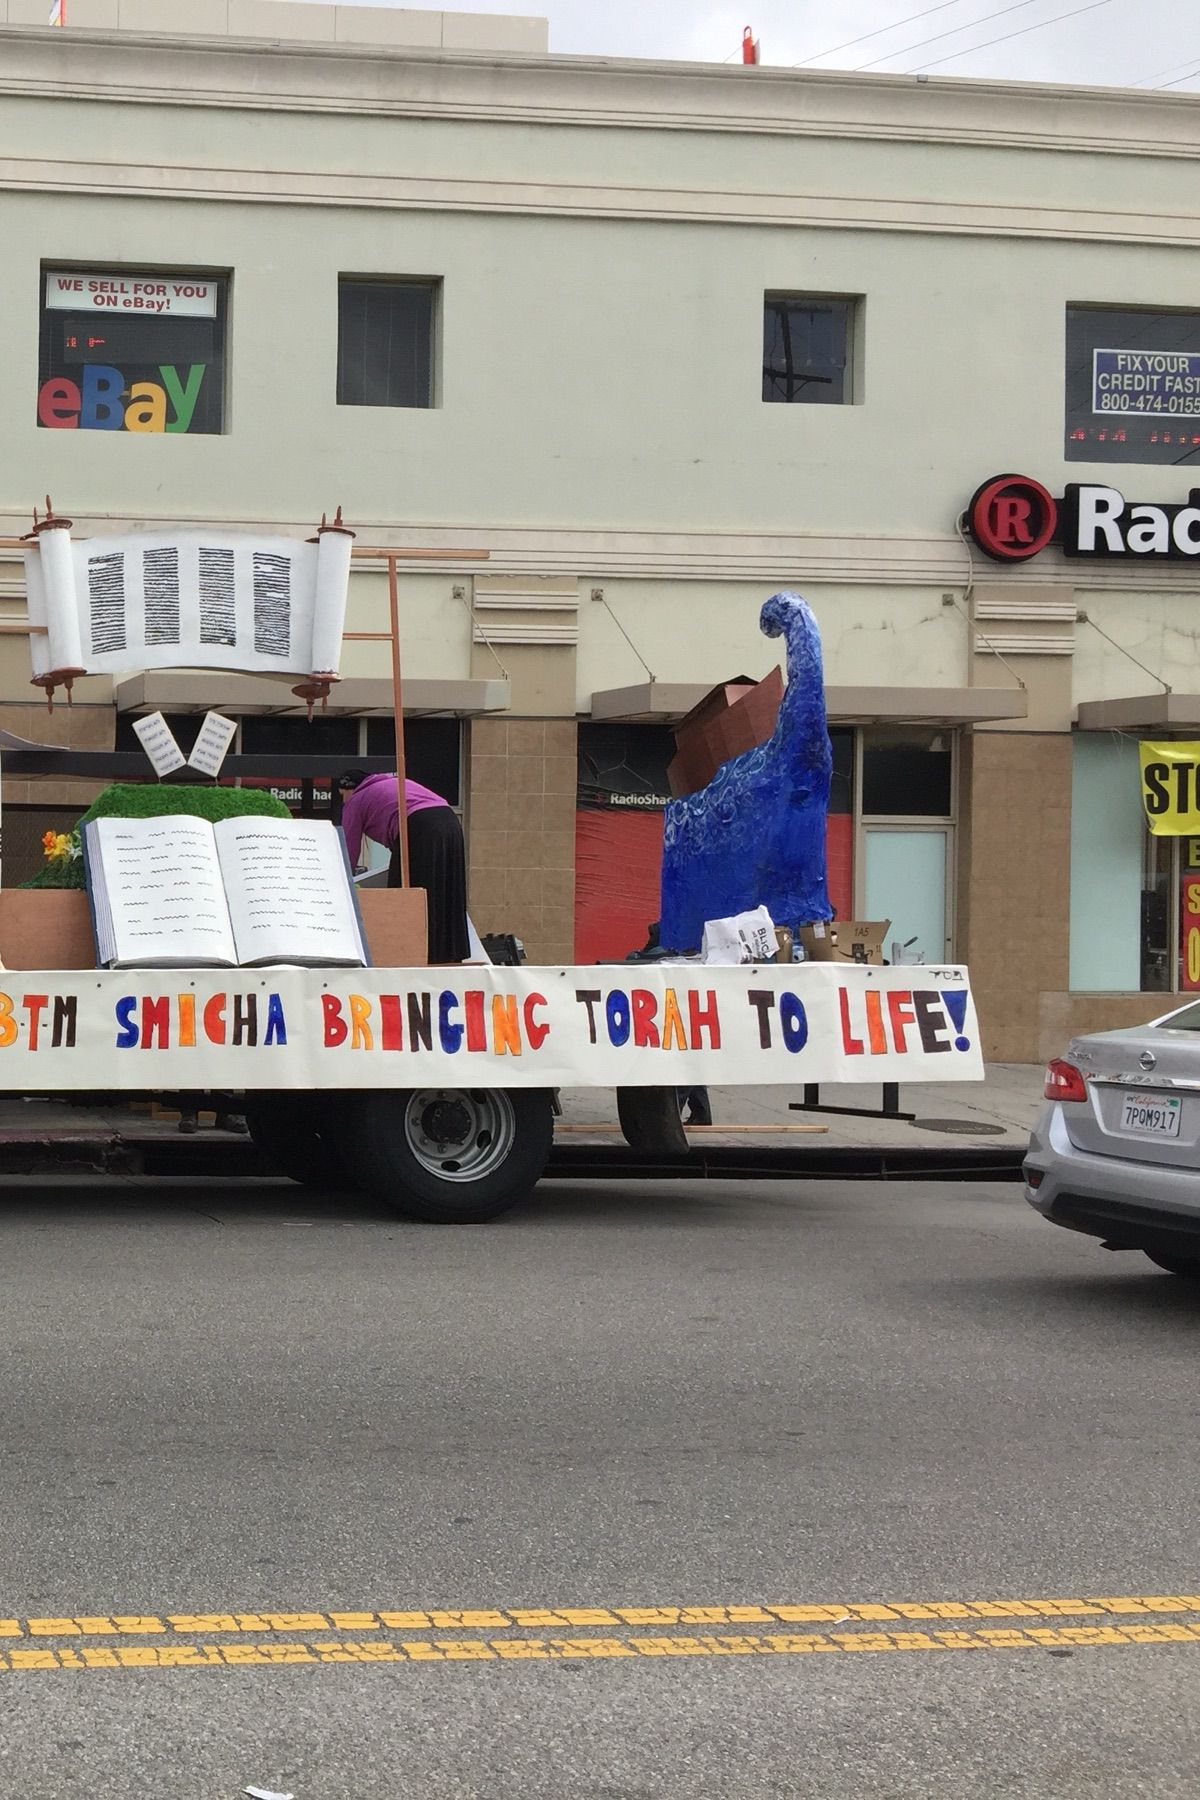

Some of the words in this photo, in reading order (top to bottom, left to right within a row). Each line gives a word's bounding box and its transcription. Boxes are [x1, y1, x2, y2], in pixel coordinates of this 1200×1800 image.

[57, 278, 84, 292] WE
[88, 281, 129, 294] SELL
[133, 283, 167, 296] FOR
[172, 285, 208, 299] YOU
[93, 294, 118, 307] ON
[122, 296, 171, 312] eBay!
[1117, 354, 1143, 372] FIX
[1144, 356, 1190, 374] YOUR
[1098, 373, 1161, 392] CREDIT
[1165, 376, 1200, 394] FAST
[38, 364, 207, 434] eBay
[1101, 393, 1200, 414] 800-474-0155
[610, 793, 674, 805] RadioShac
[1144, 762, 1200, 815] ST
[757, 927, 770, 952] BLIC
[115, 993, 287, 1050] SMICHA
[321, 989, 551, 1057] BRINGING
[576, 987, 722, 1051] TORAH
[748, 989, 809, 1054] TO
[838, 986, 971, 1056] LIFE!
